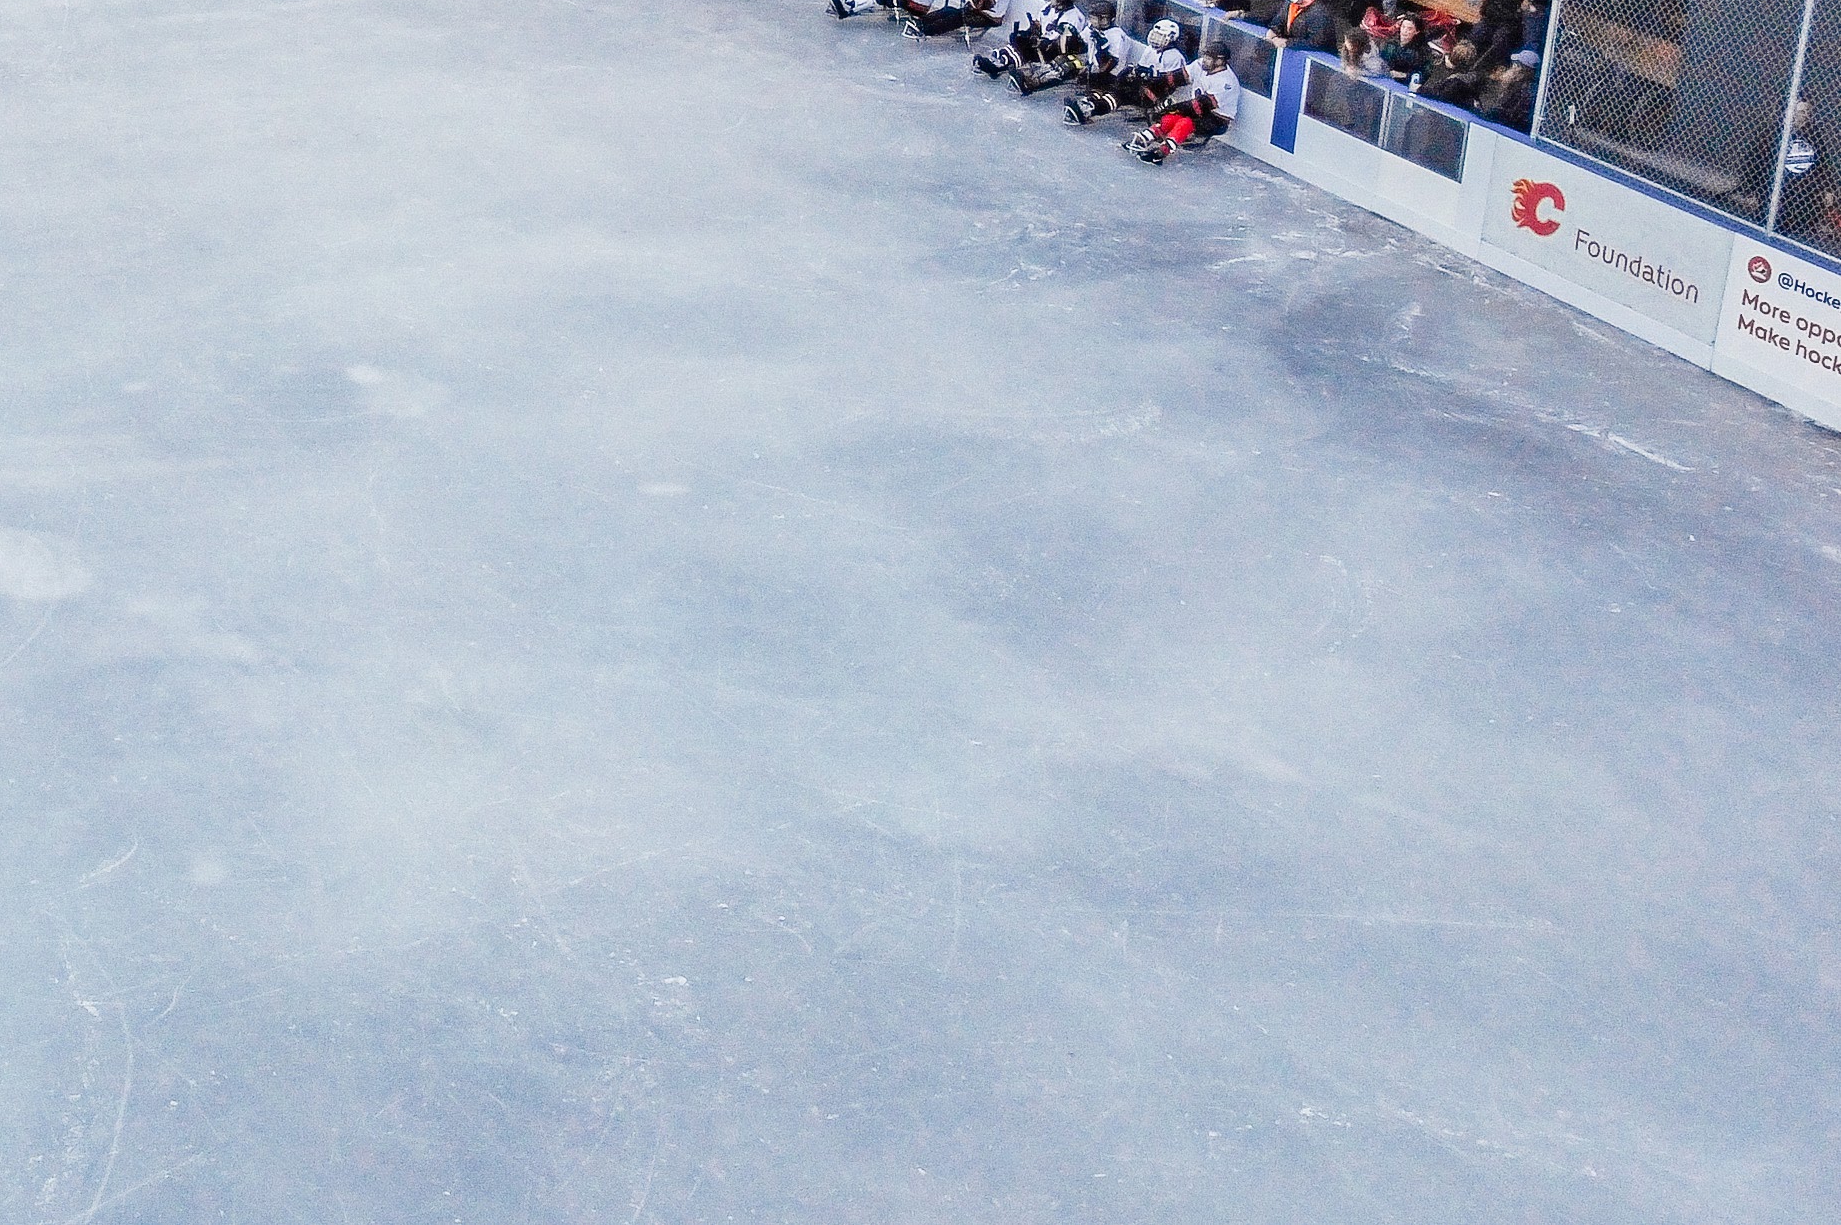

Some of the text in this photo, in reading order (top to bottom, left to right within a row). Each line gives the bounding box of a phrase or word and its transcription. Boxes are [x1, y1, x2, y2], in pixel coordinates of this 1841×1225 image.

[1573, 228, 1699, 304] Foundation
[1742, 288, 1791, 324] More
[1738, 313, 1790, 350] Make
